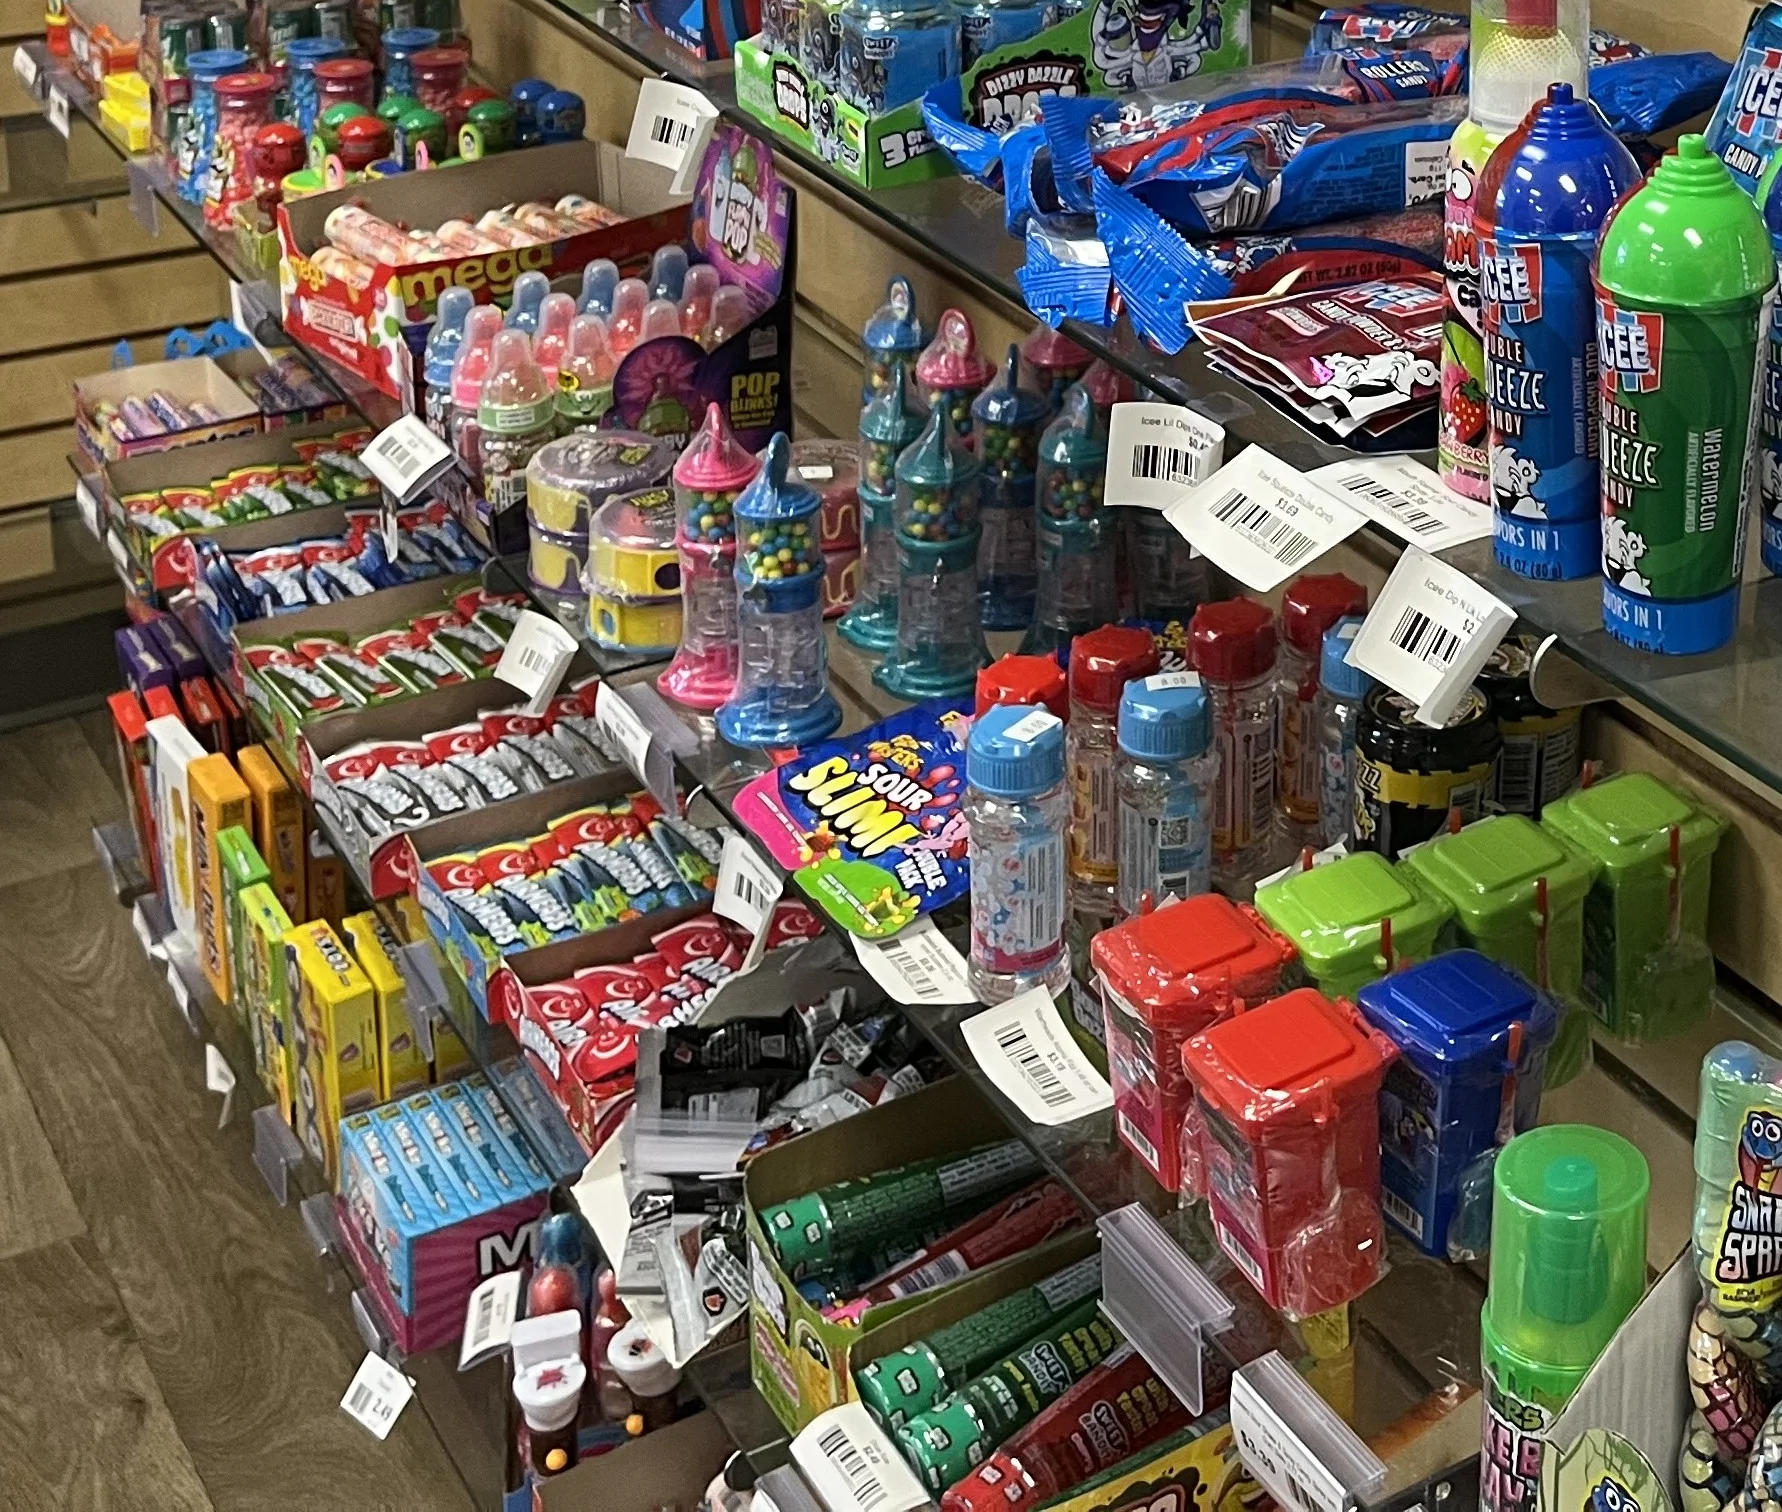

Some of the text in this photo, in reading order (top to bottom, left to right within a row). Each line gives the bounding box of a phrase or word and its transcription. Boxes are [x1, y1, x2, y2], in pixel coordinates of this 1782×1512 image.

[984, 66, 1077, 97] DIZZY DAZZLE
[1359, 59, 1431, 80] ROLLERS
[1395, 74, 1429, 89] CANDY
[879, 133, 907, 169] 3
[1723, 143, 1760, 176] CANDY
[400, 245, 554, 308] mega
[731, 371, 780, 398] POP
[1141, 416, 1161, 427] Icee
[1163, 417, 1174, 428] Lil
[1700, 427, 1723, 533] Watermelon
[1424, 577, 1445, 596] Icee
[856, 762, 934, 811] SOUR
[1036, 1342, 1071, 1387] SWEET
[1095, 1404, 1129, 1452] SWEET
